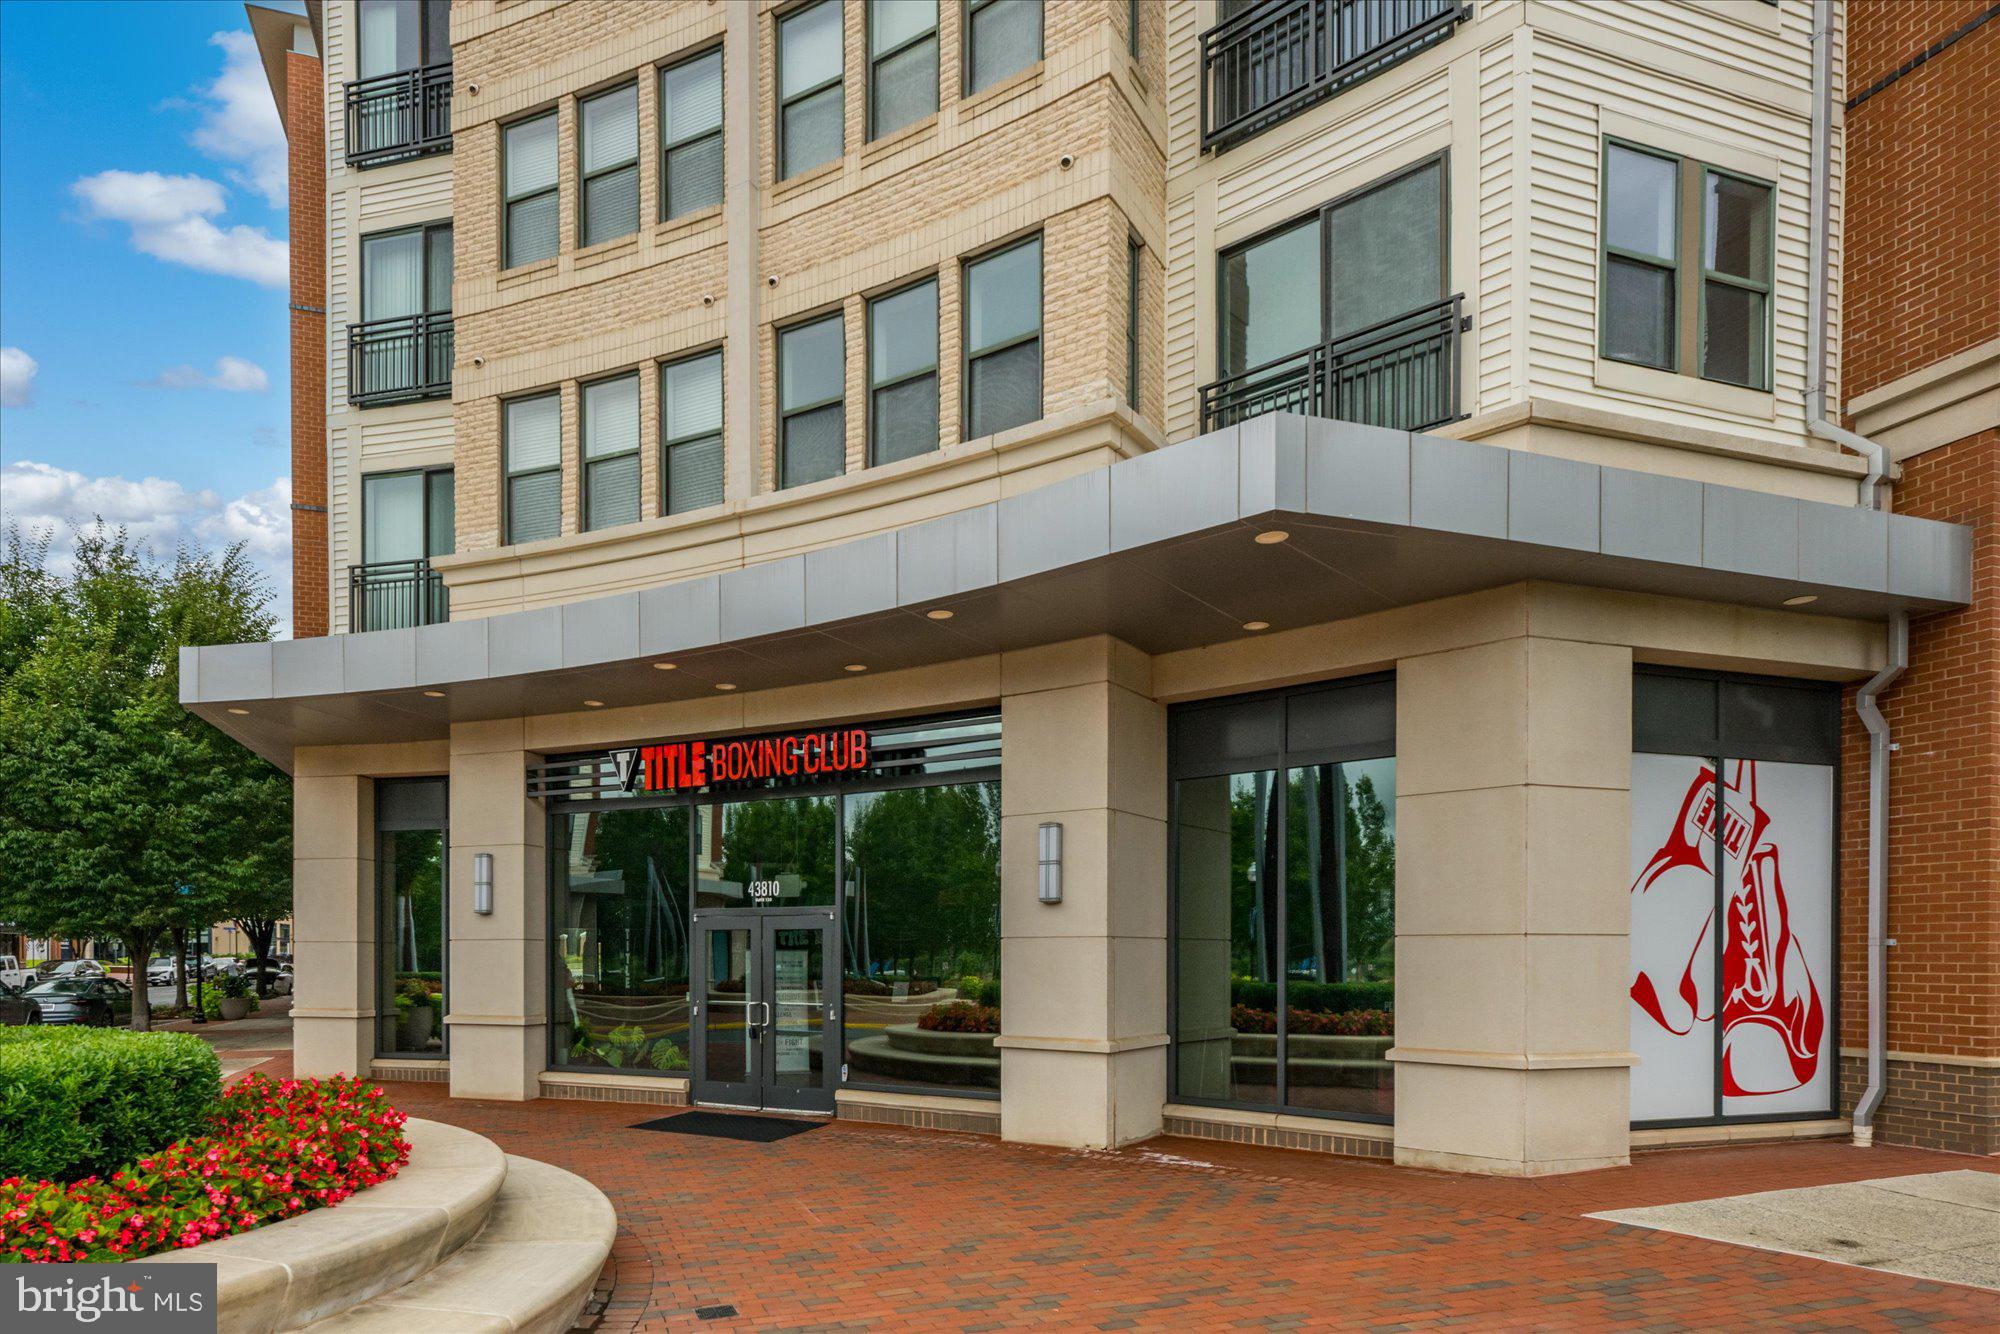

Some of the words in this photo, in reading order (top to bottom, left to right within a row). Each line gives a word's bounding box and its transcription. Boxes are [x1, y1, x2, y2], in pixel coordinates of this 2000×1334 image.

[641, 741, 706, 790] TITLE
[712, 736, 798, 781] BOXING
[803, 729, 867, 773] CLUB
[748, 880, 780, 897] 43810
